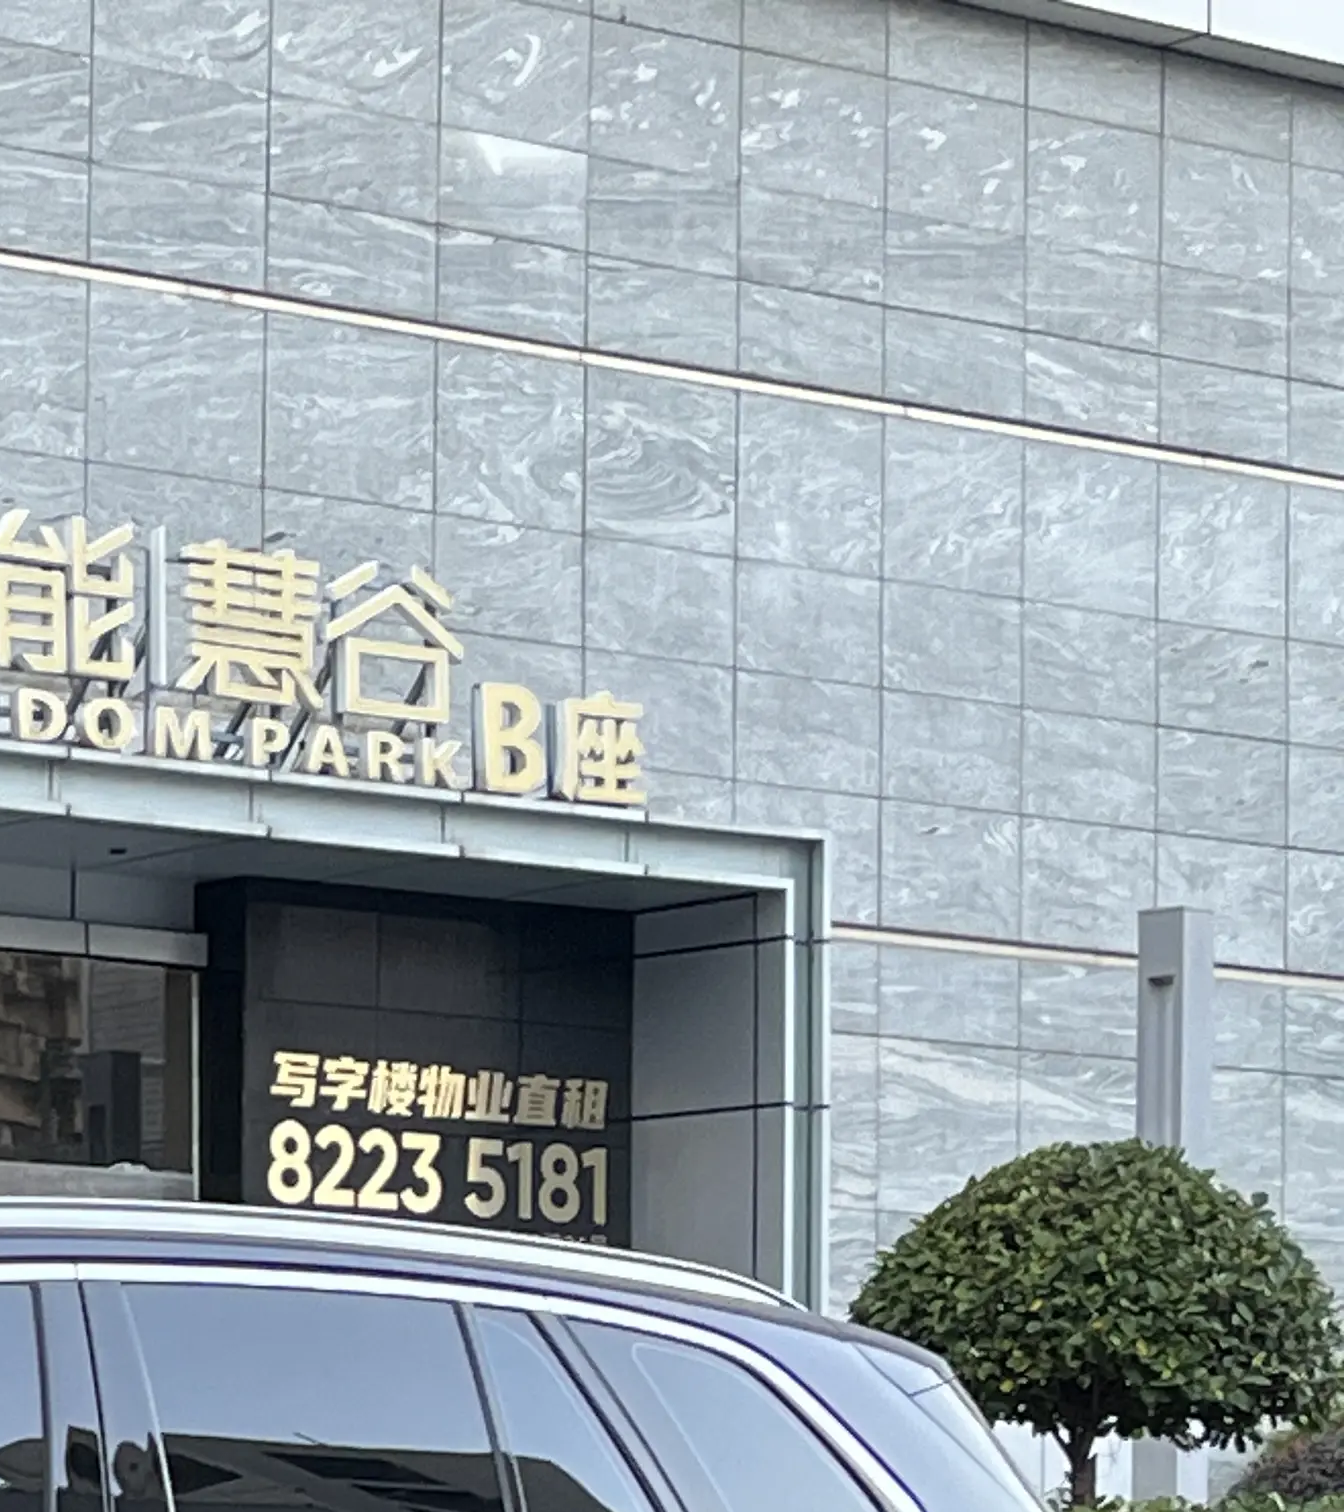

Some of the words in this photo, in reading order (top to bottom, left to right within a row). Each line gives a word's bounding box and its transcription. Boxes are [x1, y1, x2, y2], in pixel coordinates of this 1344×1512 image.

[173, 537, 465, 725] 慧谷
[246, 716, 464, 790] PARK
[472, 680, 648, 805] B座
[268, 1049, 610, 1132] 写字楼物业直租
[266, 1117, 443, 1215] 8223
[463, 1136, 609, 1227] 5181
